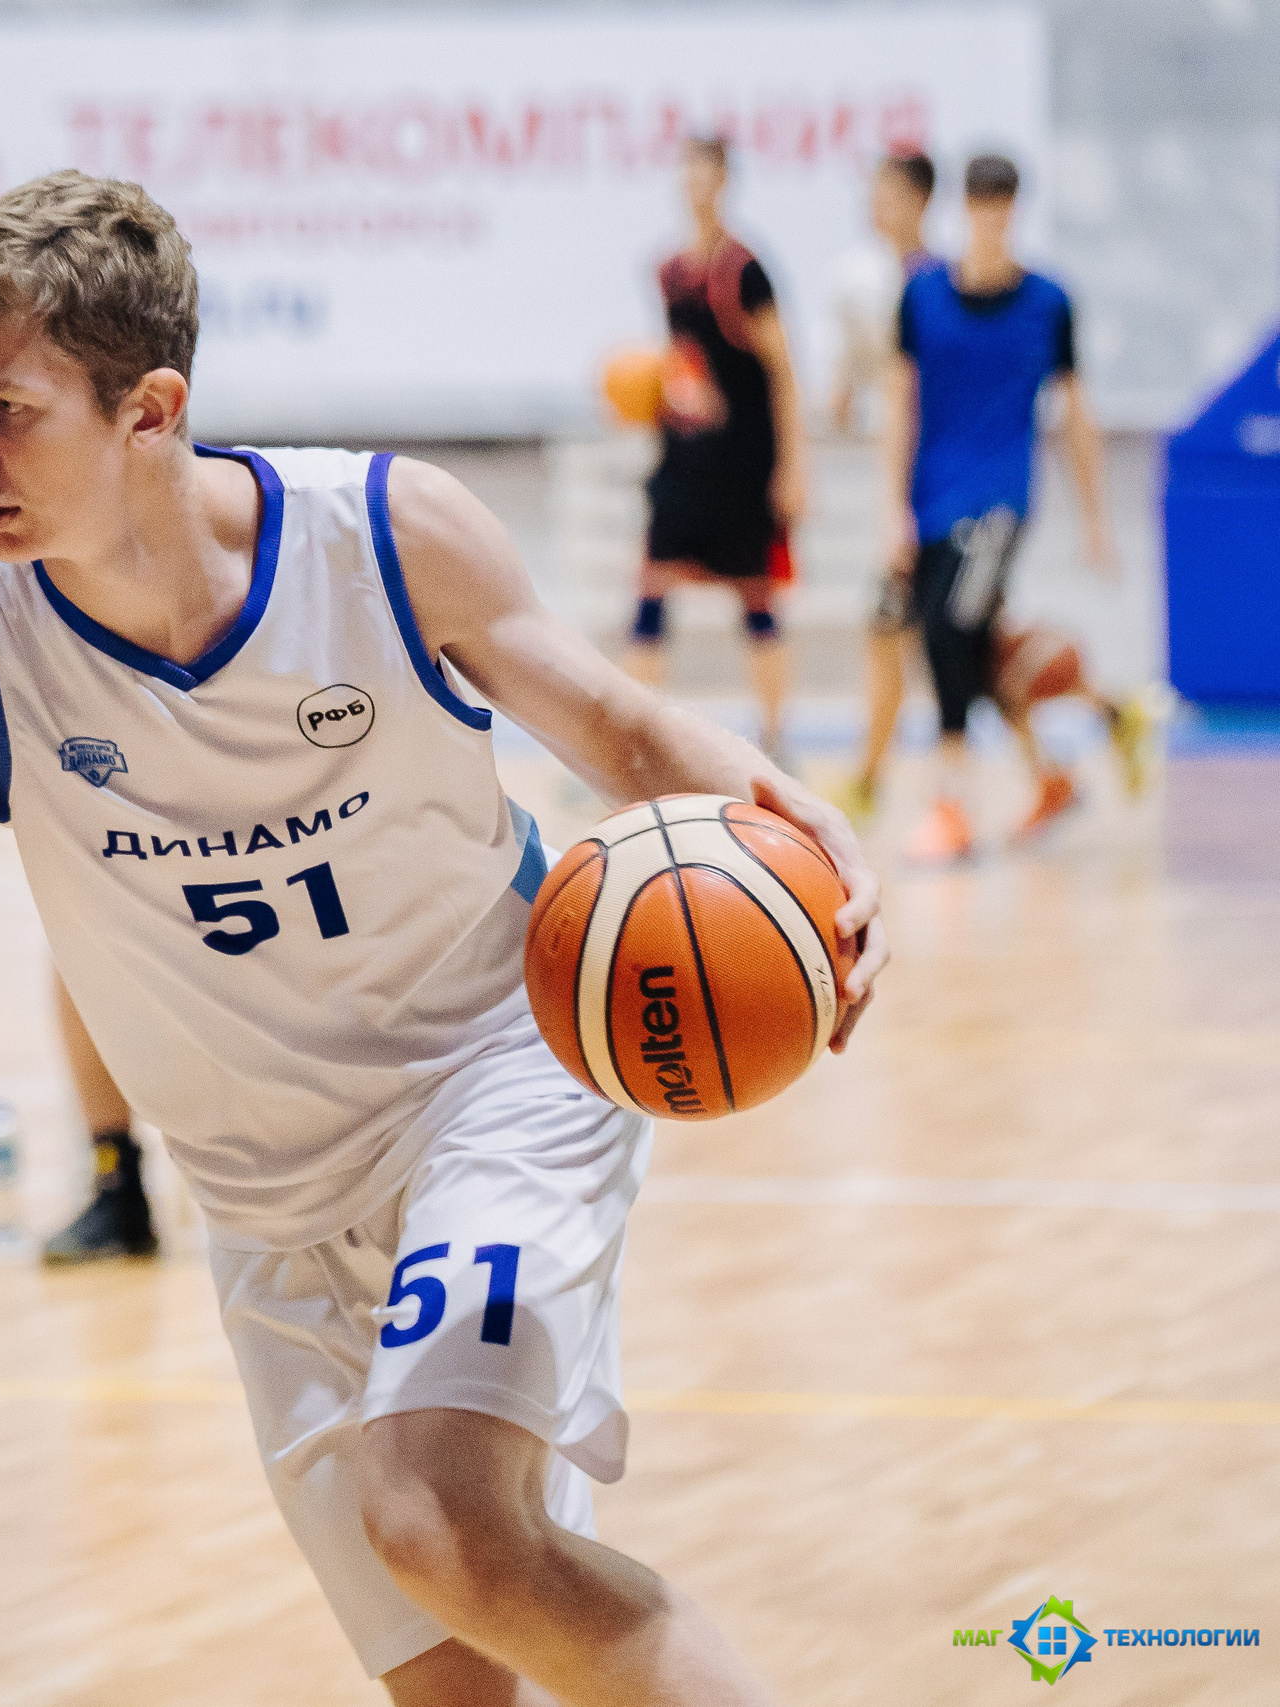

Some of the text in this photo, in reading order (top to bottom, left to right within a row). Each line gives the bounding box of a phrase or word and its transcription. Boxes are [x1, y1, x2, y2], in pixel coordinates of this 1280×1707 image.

[307, 699, 366, 731] РФБ
[102, 791, 370, 860] ДИНАМО
[182, 861, 350, 956] 51
[639, 965, 708, 1114] molten
[380, 1242, 521, 1347] 51
